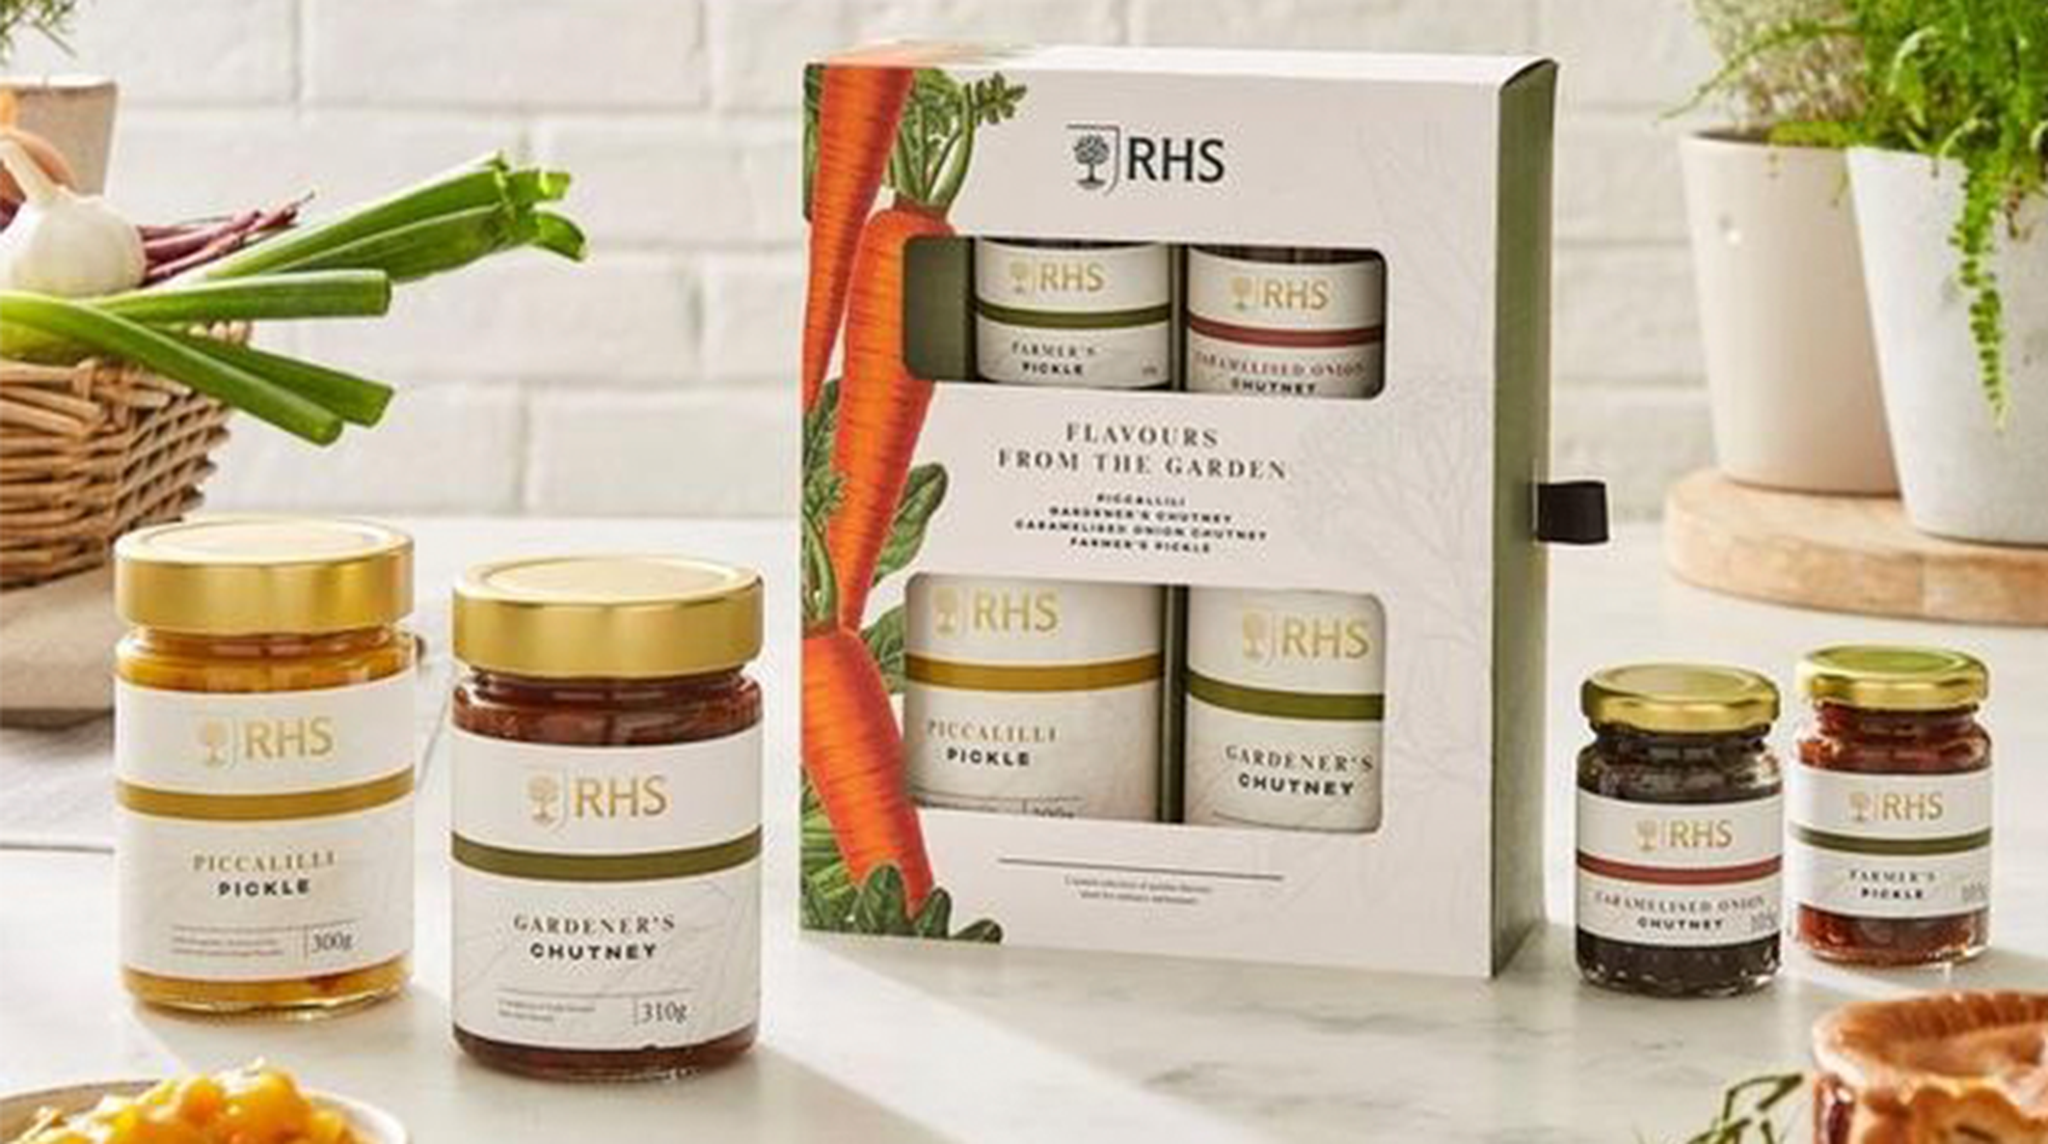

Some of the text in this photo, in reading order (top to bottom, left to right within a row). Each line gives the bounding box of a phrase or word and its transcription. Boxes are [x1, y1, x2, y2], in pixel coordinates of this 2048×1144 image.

[1127, 137, 1225, 184] RHS
[1041, 262, 1105, 292] RHS
[1263, 280, 1330, 311] RHS
[1022, 361, 1082, 375] PICKLE
[1231, 377, 1317, 394] CHUTNEY
[1066, 422, 1218, 448] FLAVOURS
[998, 448, 1287, 479] FROM THE GARDEN
[1049, 506, 1231, 523] GARDENER'S CHUTNEY
[1015, 519, 1267, 541] CARAMELISED ONION CHUTNEY
[1070, 537, 1210, 554] FARMER'S PICKLE
[972, 592, 1060, 632] RHS
[1281, 618, 1370, 659] RHS
[245, 716, 335, 759] RHS
[928, 720, 1056, 743] PICCALILLI
[946, 747, 1030, 767] PICKLE
[1225, 745, 1374, 773] GARDENER'S
[573, 774, 668, 819] RHS
[1238, 773, 1356, 798] CHUTNEY
[1883, 792, 1944, 821] RHS
[1670, 819, 1733, 848] RHS
[193, 850, 336, 873] PICCALILLI
[1850, 869, 1936, 882] FARMER'S
[218, 878, 311, 897] PICKLE
[1861, 888, 1924, 899] PICKLE
[1595, 891, 1765, 913] CARAMELISED ONION
[513, 914, 676, 935] GARDENER'S
[1637, 916, 1724, 930] CHUTNEY
[312, 931, 353, 954] 300g
[530, 942, 657, 960] CHUTNEY
[641, 1000, 688, 1025] 310g
